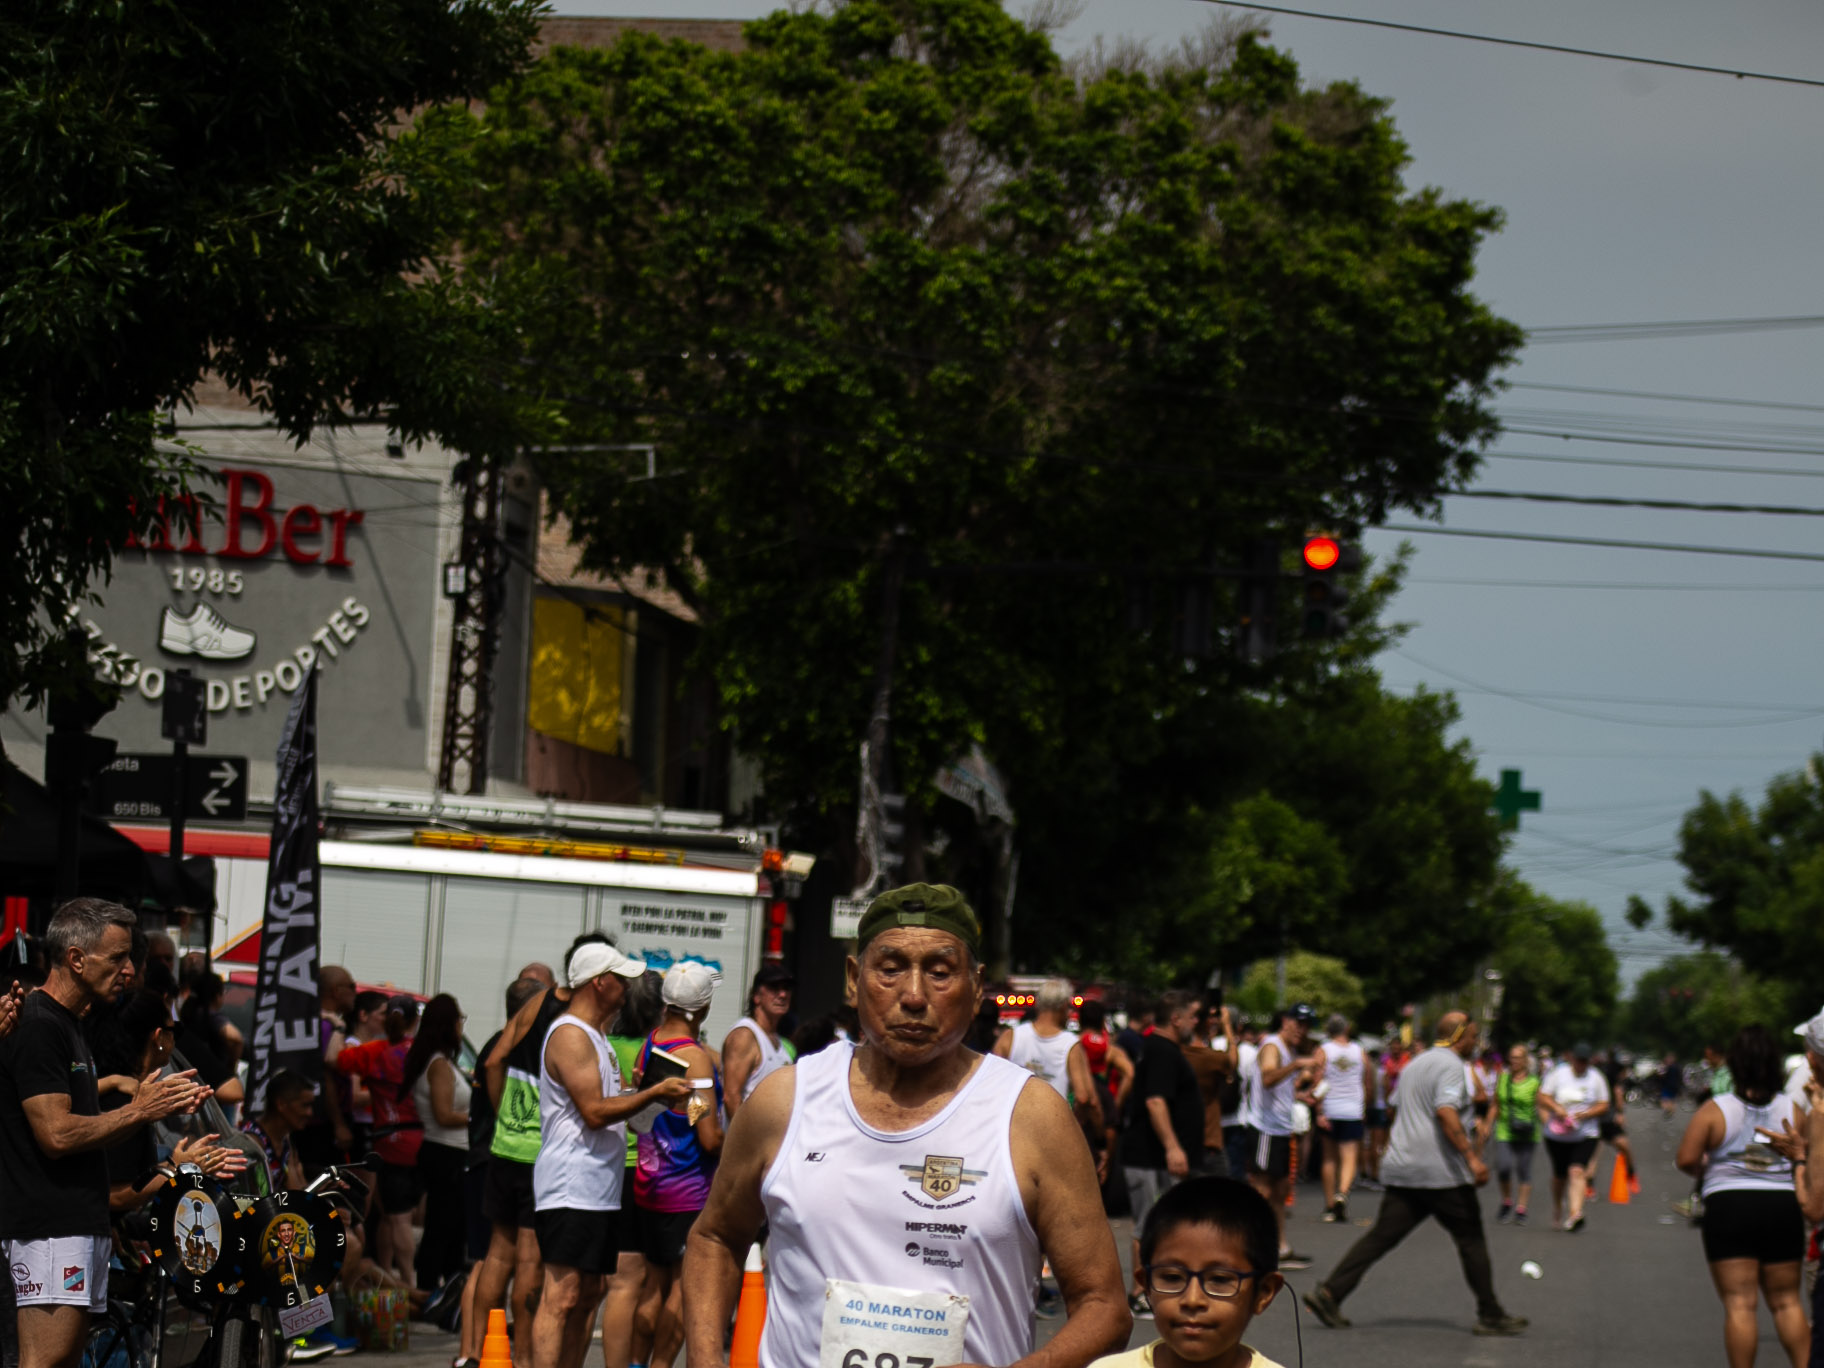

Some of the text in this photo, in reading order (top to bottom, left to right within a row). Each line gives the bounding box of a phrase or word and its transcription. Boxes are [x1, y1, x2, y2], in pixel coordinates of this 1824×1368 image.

[170, 566, 244, 595] 1985
[206, 596, 371, 712] DEPORTES
[272, 868, 321, 1054] EAM
[191, 1174, 204, 1189] 12
[929, 1179, 952, 1192] 40
[274, 1191, 289, 1206] 12
[902, 1190, 976, 1210] EMPALME GRANEROS
[150, 1217, 158, 1231] 9
[238, 1237, 246, 1251] 3
[336, 1233, 345, 1247] 3
[923, 1247, 949, 1257] Banco
[923, 1257, 964, 1270] Municipal
[194, 1279, 201, 1293] 6
[287, 1292, 295, 1305] 6
[845, 1299, 946, 1321] 40 MARATON
[283, 1307, 326, 1331] VENTA
[840, 1316, 949, 1336] EMPALME GRANEROS
